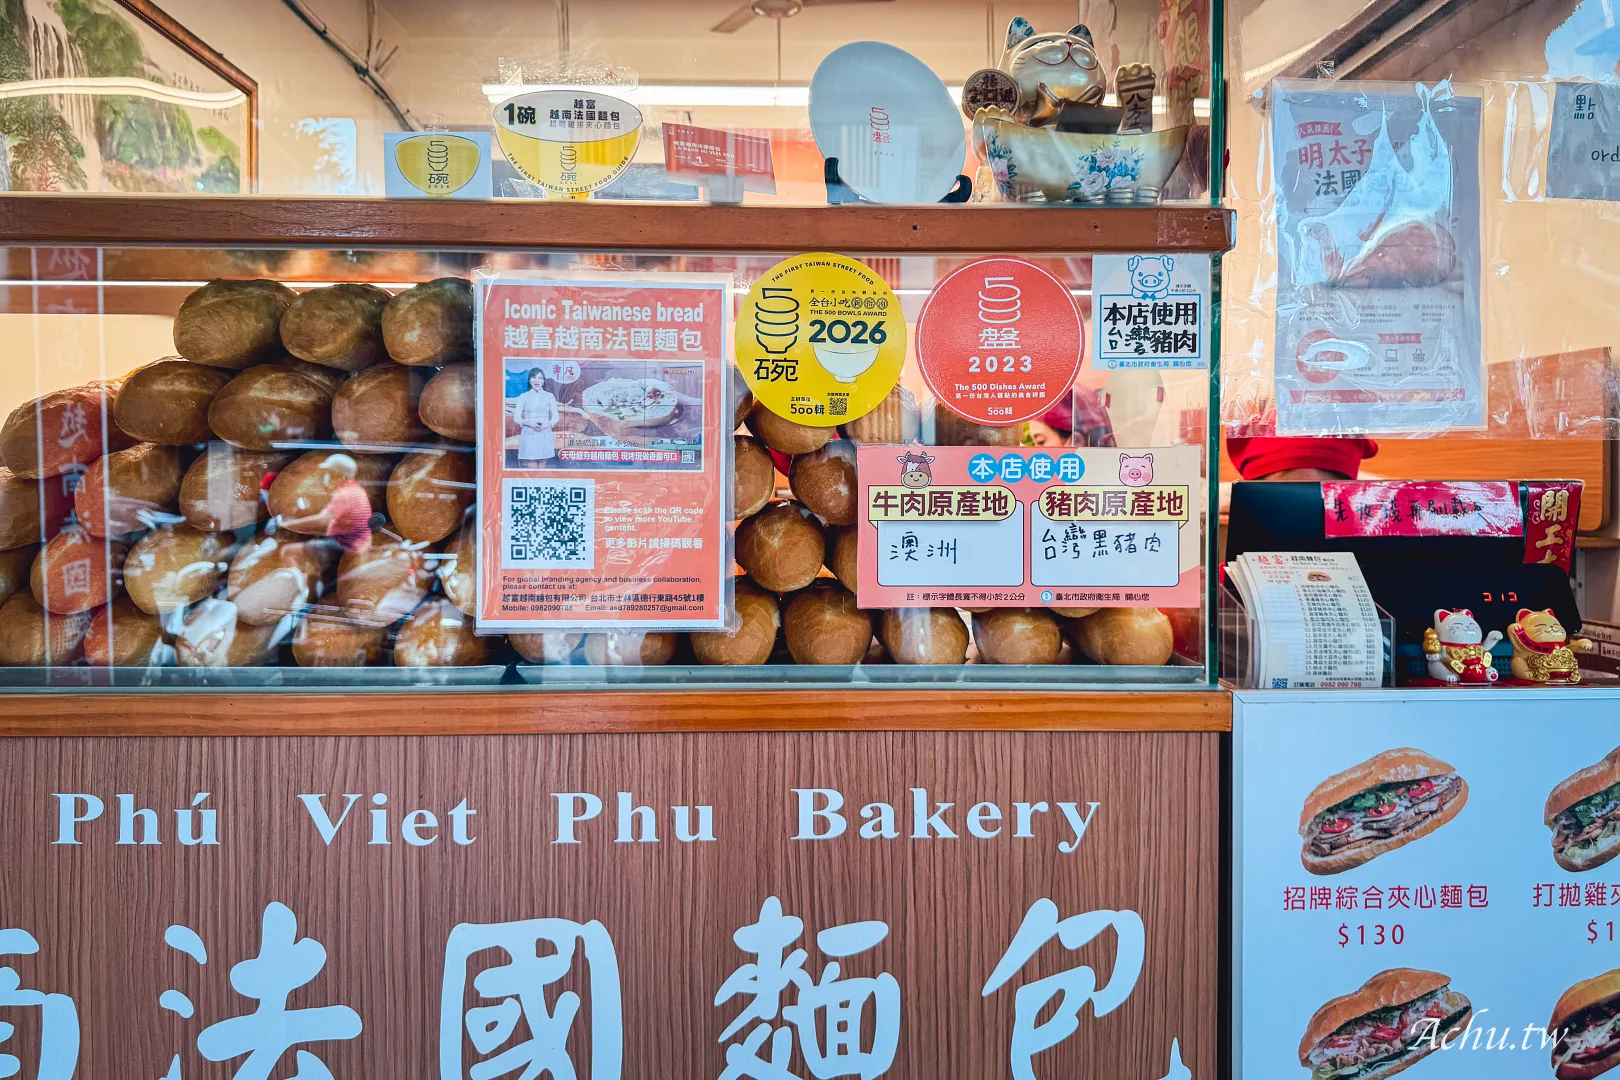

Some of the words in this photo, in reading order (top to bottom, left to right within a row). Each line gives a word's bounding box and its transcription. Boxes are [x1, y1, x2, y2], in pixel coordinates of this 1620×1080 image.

[503, 102, 536, 125] 1碗
[550, 110, 620, 121] 越南法國麵包
[574, 99, 596, 110] 越富
[1298, 139, 1372, 170] 明太子
[507, 152, 518, 166] THE
[518, 166, 535, 181] FIRST
[537, 180, 564, 192] TAIWAN
[566, 185, 593, 193] STREET
[594, 175, 612, 187] FOOD
[612, 156, 629, 175] GUIDE
[772, 273, 784, 283] THE
[784, 263, 804, 275] FIRST
[833, 262, 857, 274] STREET
[858, 272, 874, 286] FOOD
[504, 298, 556, 320] Iconic
[562, 300, 652, 322] Taiwanese
[657, 302, 704, 323] bread
[1103, 302, 1198, 326] 本店使用
[504, 325, 704, 352] 越富越南法國麵包
[808, 320, 887, 345] 2026
[754, 358, 799, 382] 碗
[968, 356, 1032, 373] 2023
[1019, 382, 1046, 390] Award
[971, 457, 1081, 480] 本店使用
[684, 507, 704, 515] code
[872, 490, 1009, 517] 牛肉原產地
[1045, 490, 1184, 517] 豬肉原產地
[605, 537, 703, 549] 更多影片請掃碼觀看
[889, 532, 958, 564] 澳洲
[542, 576, 574, 584] branding
[502, 594, 587, 603] 越富越南麵包有限公司
[610, 604, 704, 612] asd789280257@gmail.com
[51, 792, 220, 846] Phú
[297, 792, 477, 846] Viet
[550, 791, 717, 844] Phu
[790, 787, 1101, 853] Bakery
[1283, 884, 1490, 911] 招牌綜合夾心麵包
[1338, 923, 1406, 948] $130
